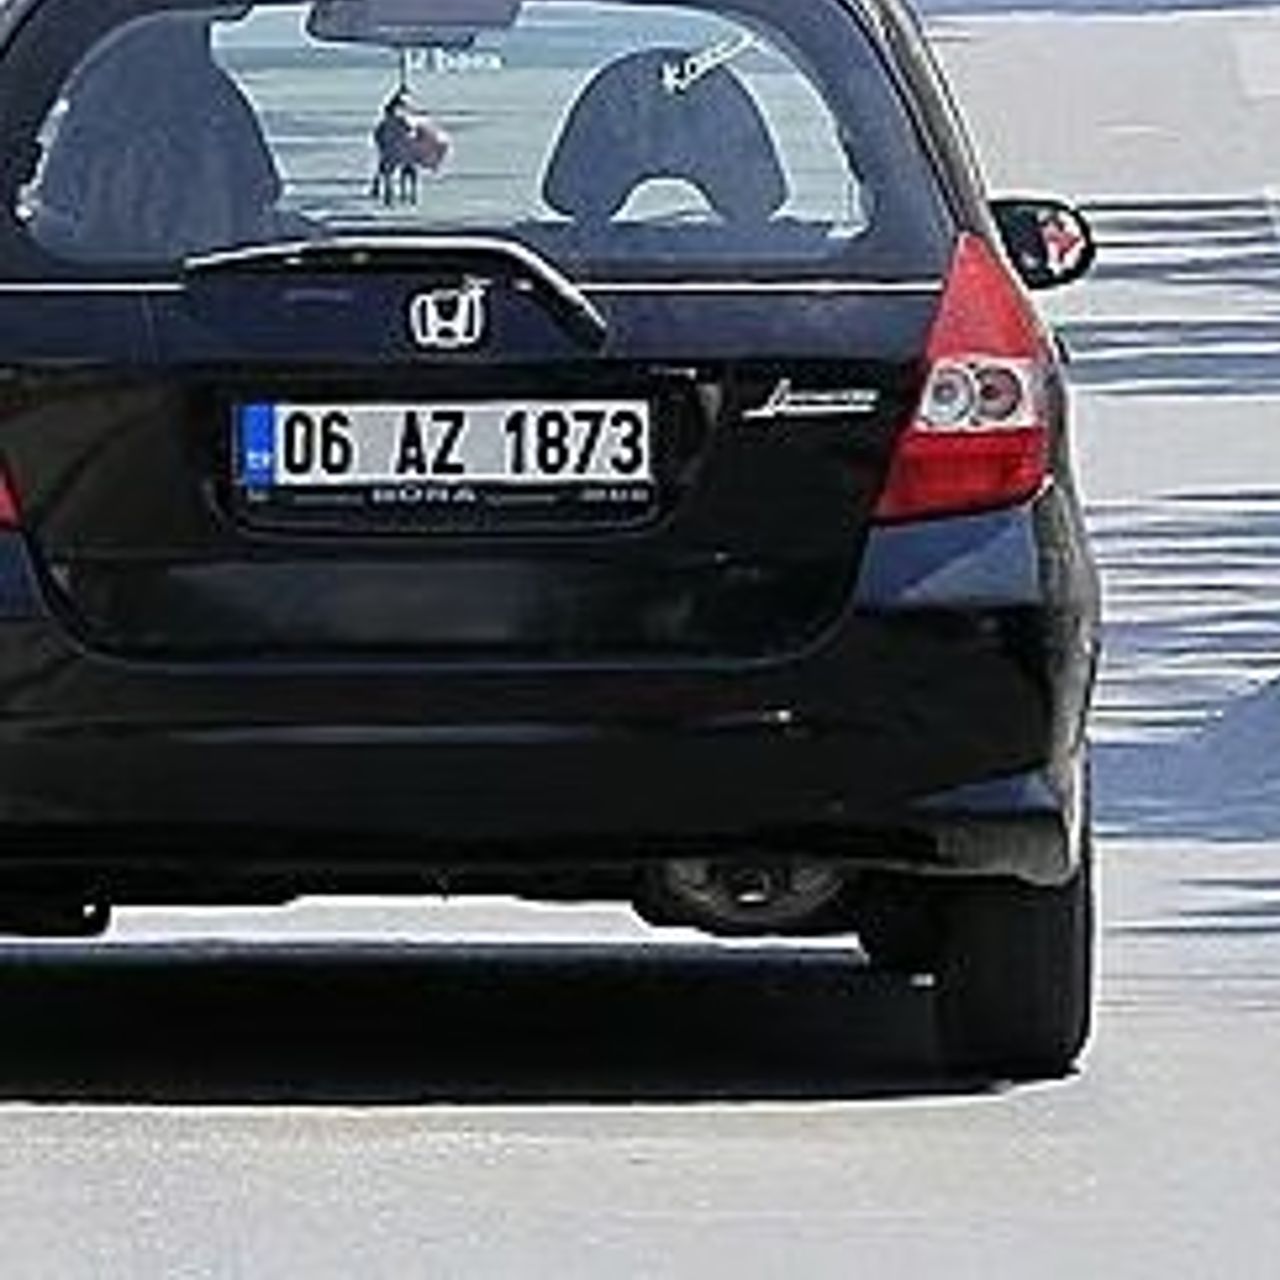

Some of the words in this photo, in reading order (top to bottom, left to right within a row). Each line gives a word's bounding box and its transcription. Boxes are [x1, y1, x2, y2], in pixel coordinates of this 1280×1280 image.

[283, 410, 353, 475] 06
[396, 410, 465, 475] AZ
[505, 410, 644, 475] 1873
